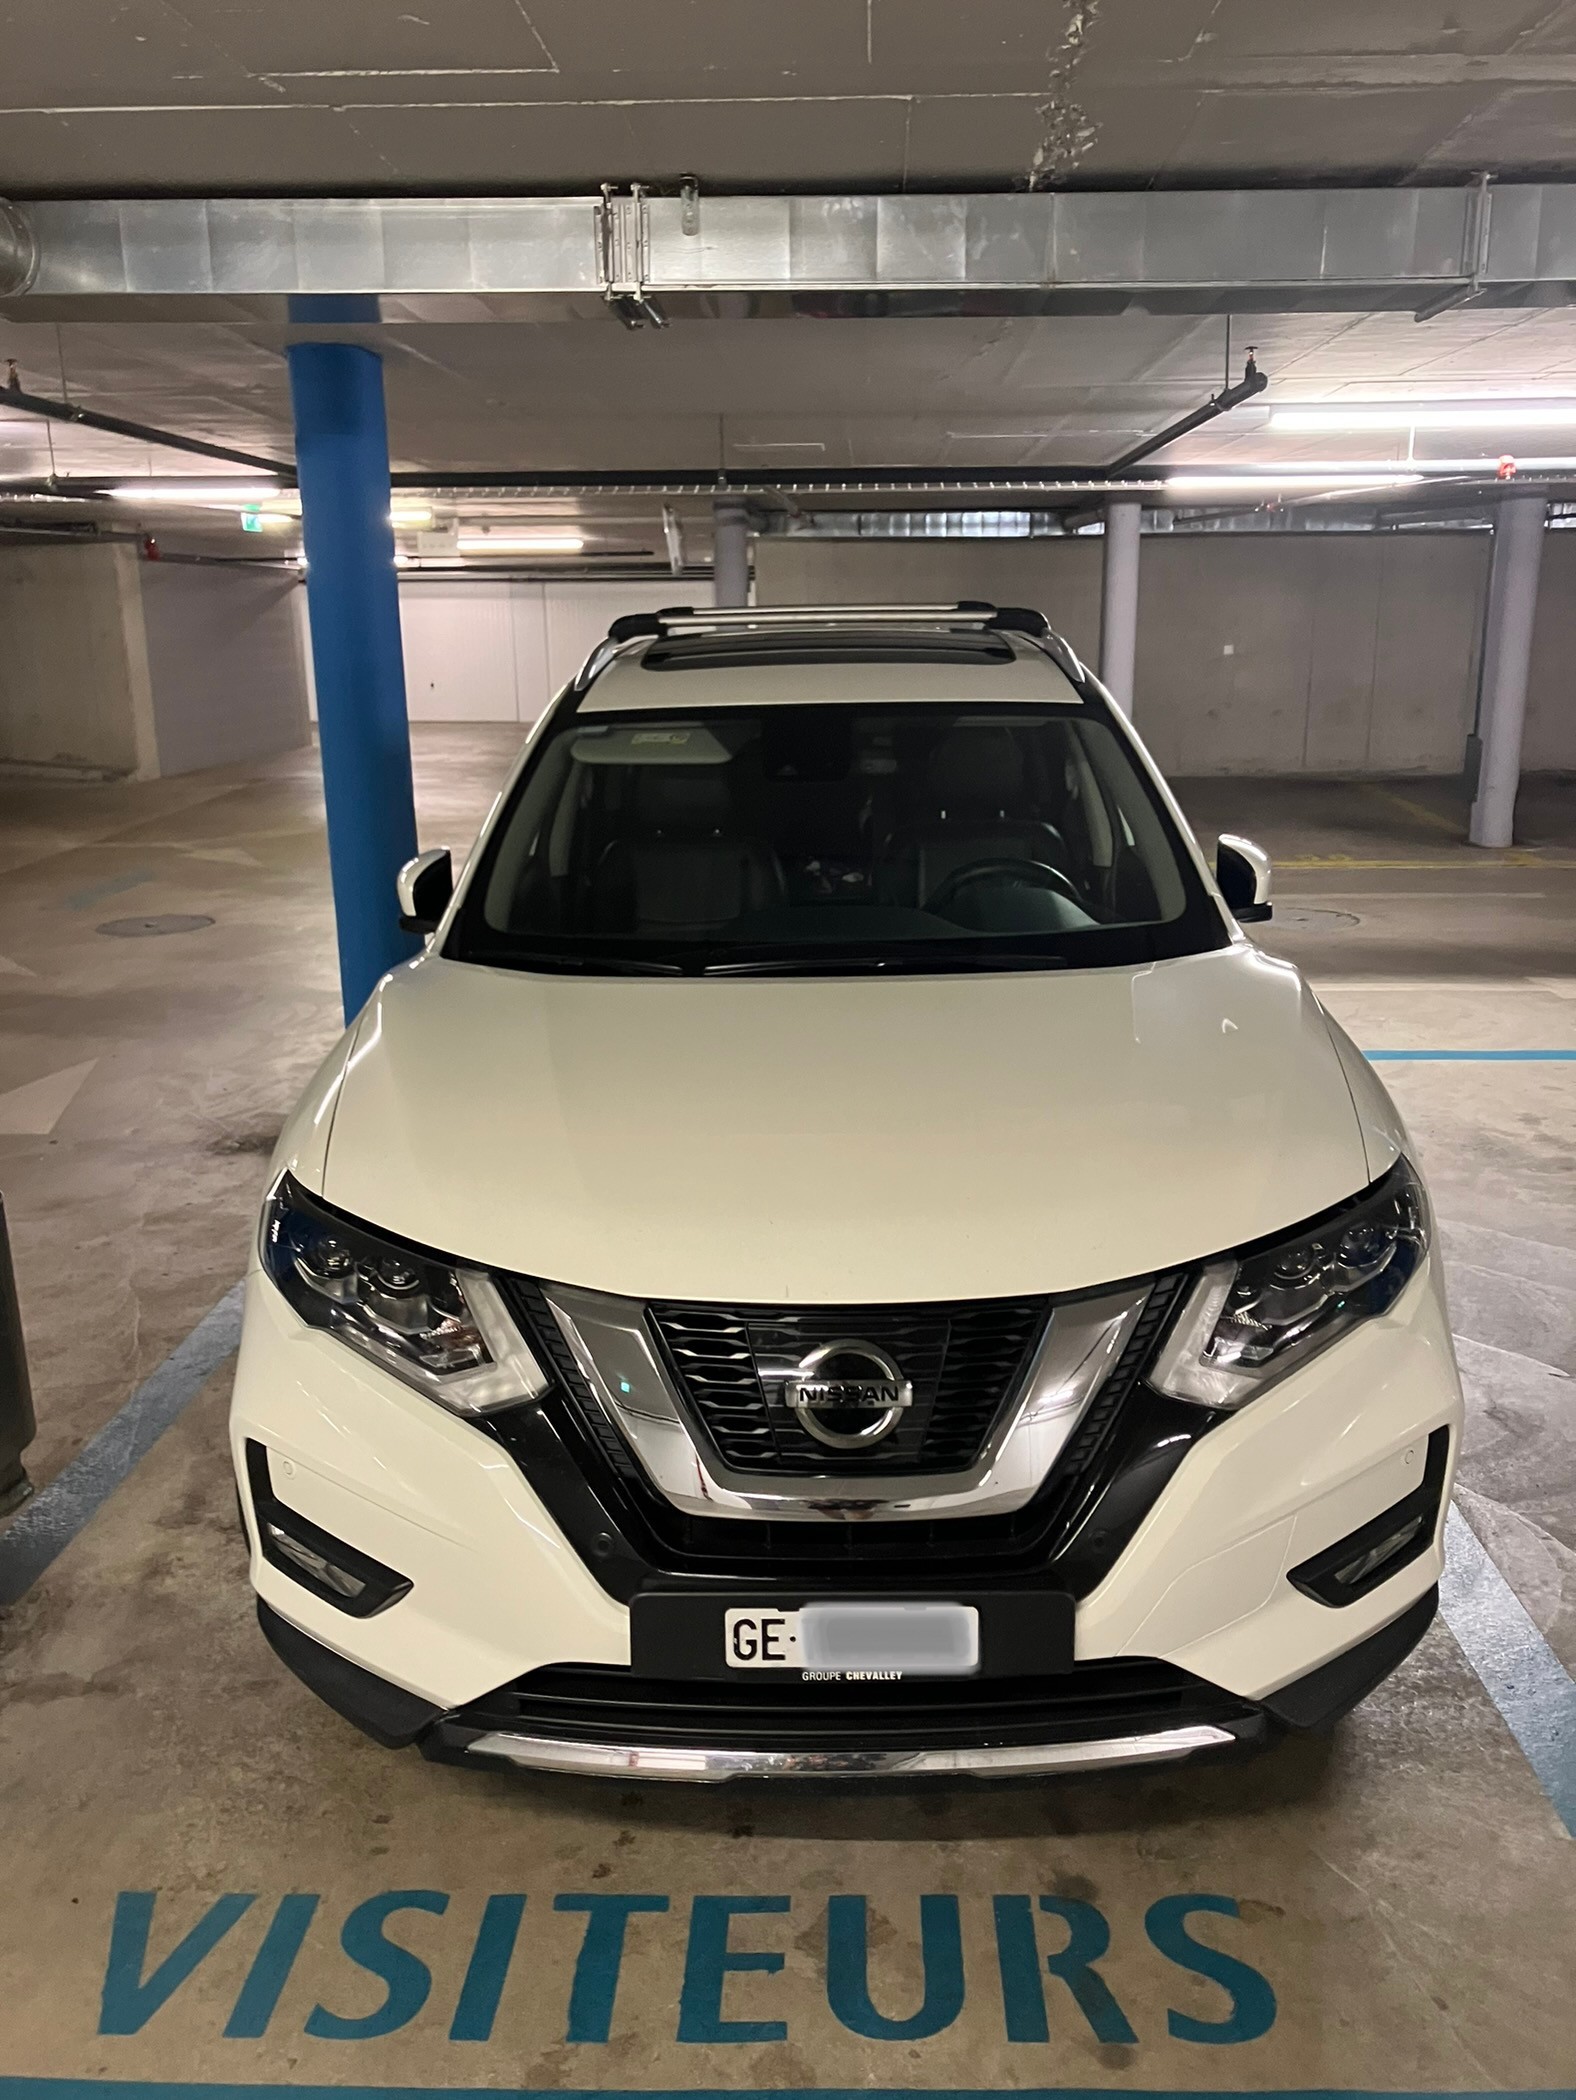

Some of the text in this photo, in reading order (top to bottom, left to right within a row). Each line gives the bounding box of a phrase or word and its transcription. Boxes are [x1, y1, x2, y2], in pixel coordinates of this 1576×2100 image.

[800, 1386, 898, 1402] NISSAN
[802, 1671, 903, 1681] GROUPE CHEVALLEY
[98, 1889, 1279, 2043] VISITEURS
